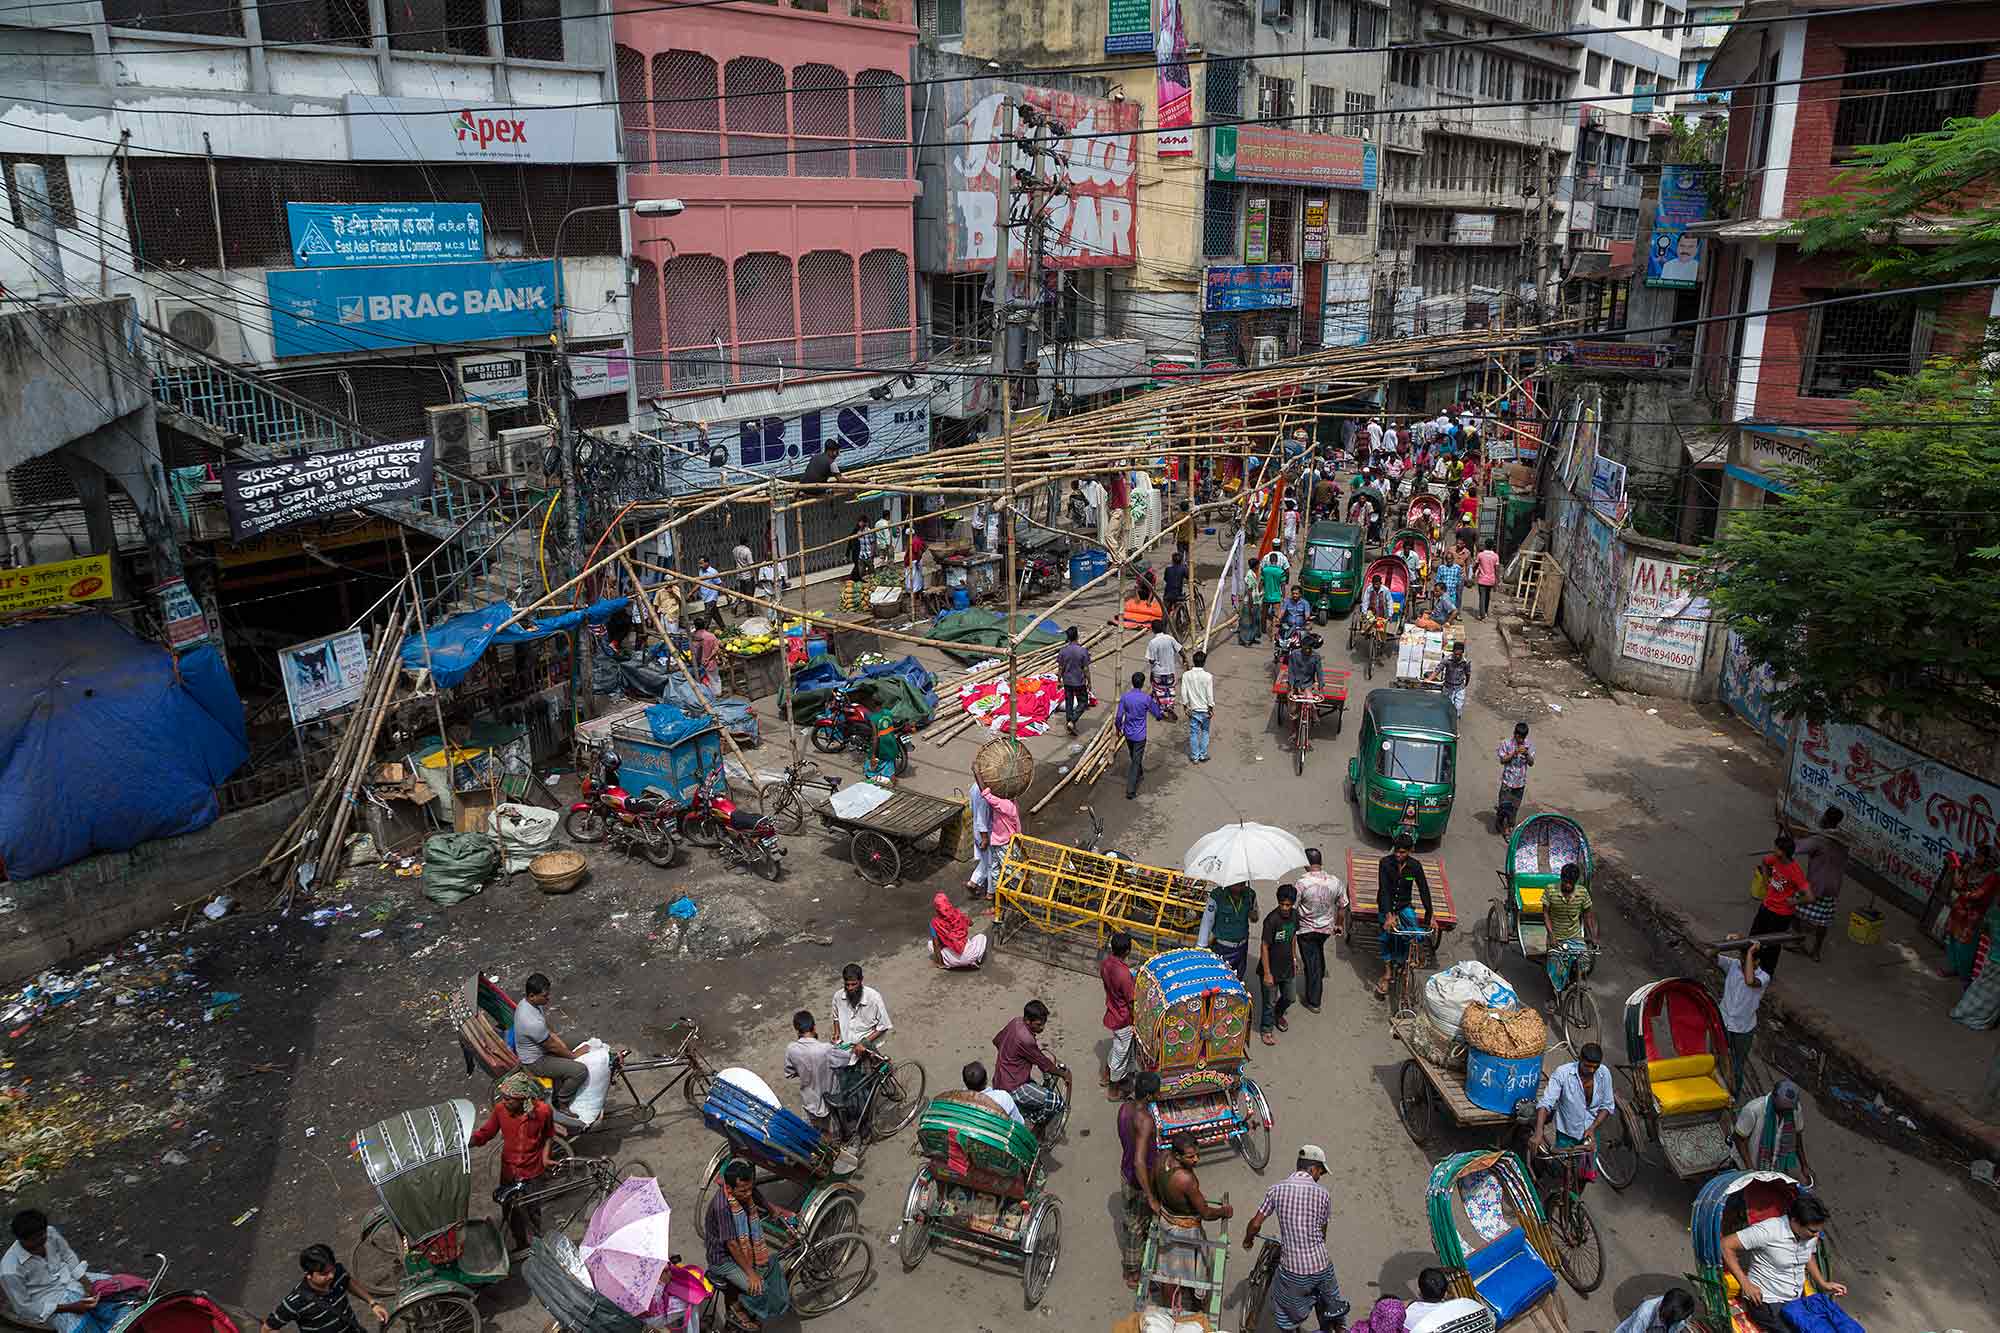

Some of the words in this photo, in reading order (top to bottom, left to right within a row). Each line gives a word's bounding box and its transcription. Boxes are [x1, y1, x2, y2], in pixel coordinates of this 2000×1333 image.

[456, 108, 528, 150] Apex
[335, 240, 353, 254] East
[353, 240, 370, 253] Asia
[371, 240, 398, 253] Finance
[399, 239, 405, 251] &
[406, 239, 443, 252] Commerce
[468, 238, 481, 251] Ltd.
[367, 291, 459, 321] BRAC
[463, 286, 549, 316] BANK
[464, 361, 510, 376] WESTERN
[479, 370, 510, 381] UNION
[1752, 436, 1777, 457] ঢাকা
[238, 479, 285, 500] জন্য
[288, 466, 335, 488] ভাড়া
[387, 452, 421, 466] হবে
[244, 497, 276, 514] ২য়
[279, 486, 317, 507] তলা
[342, 469, 374, 487] ৩য়
[376, 465, 411, 481] তলা
[1424, 797, 1437, 806] CNG
